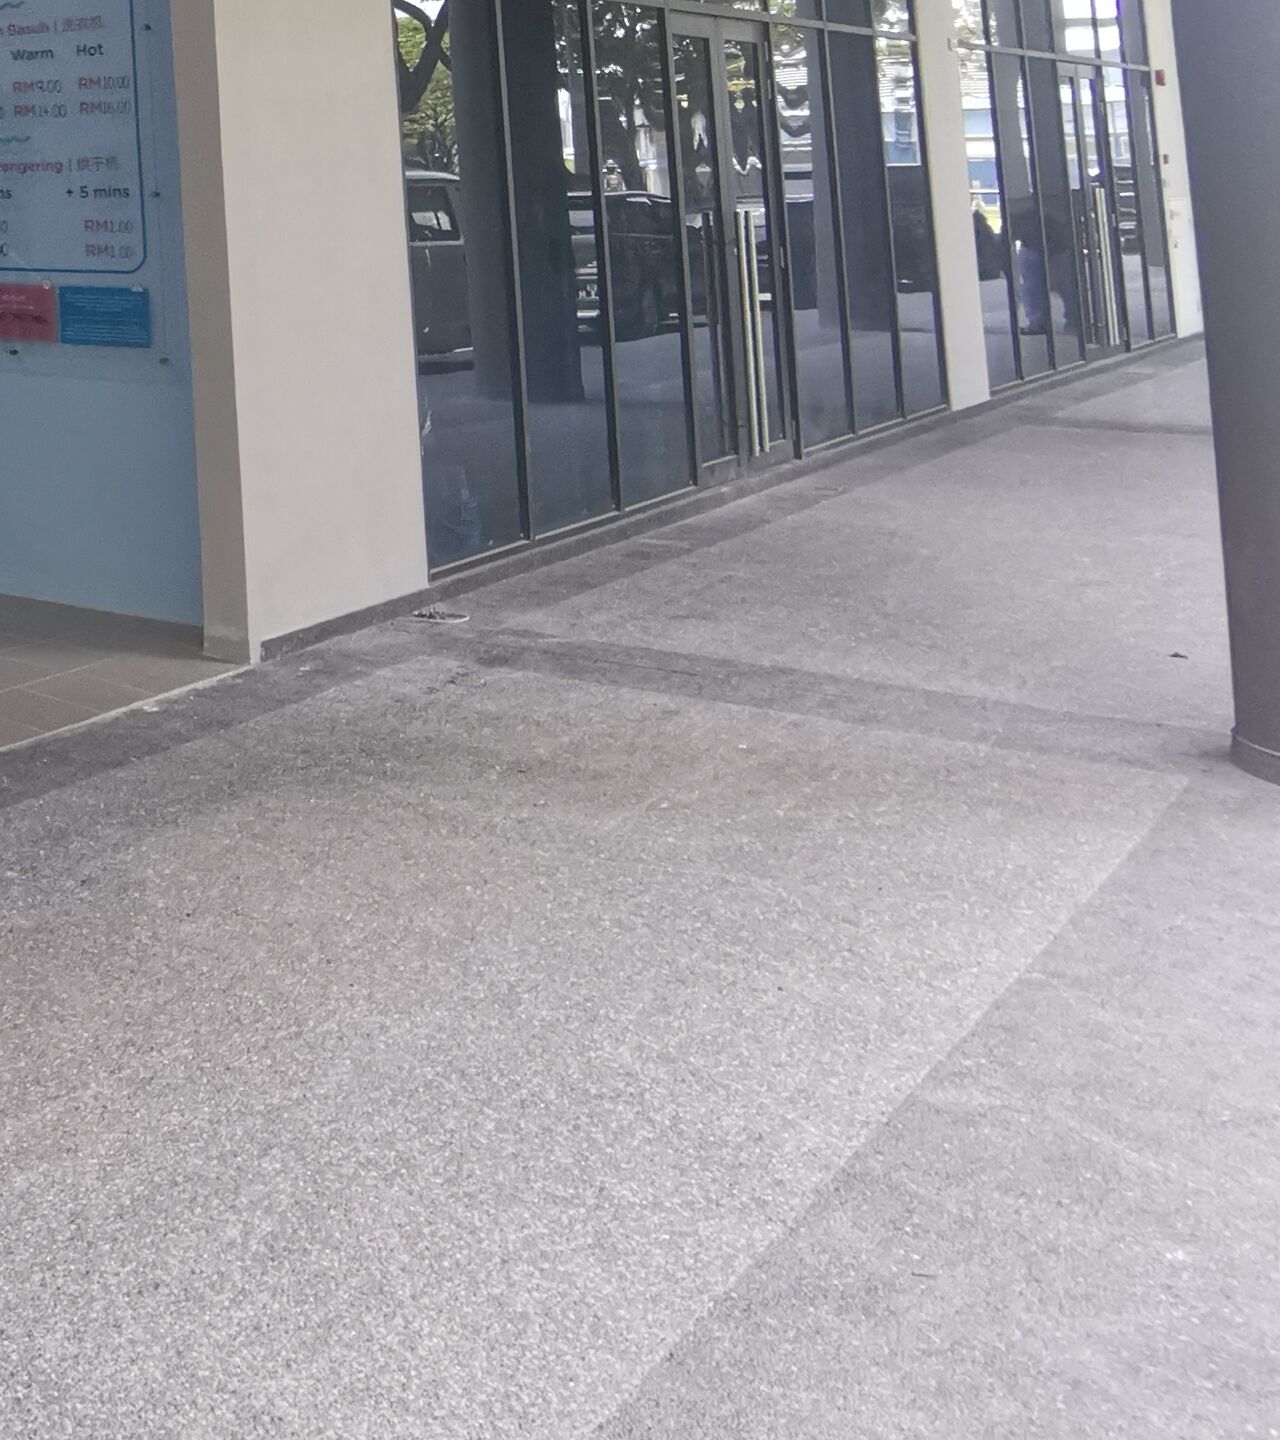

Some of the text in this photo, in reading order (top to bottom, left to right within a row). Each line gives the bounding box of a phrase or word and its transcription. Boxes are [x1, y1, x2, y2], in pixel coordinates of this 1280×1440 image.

[11, 47, 54, 61] Warm
[76, 43, 104, 57] Hot
[80, 185, 89, 199] 5
[93, 185, 130, 199] mins
